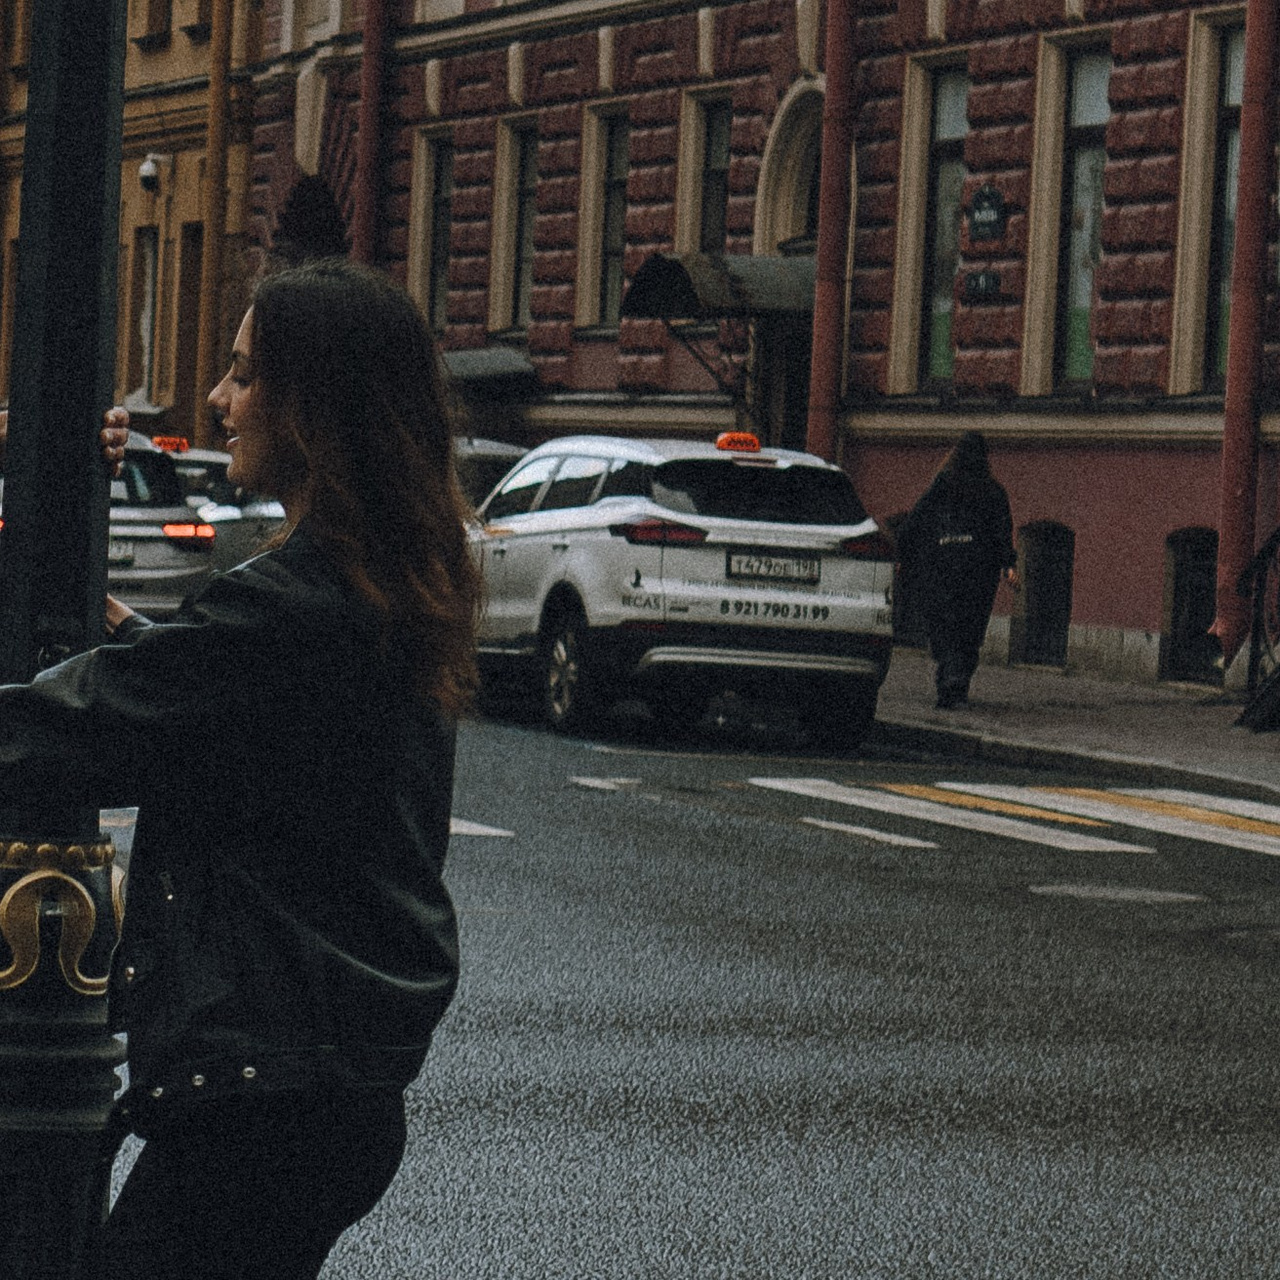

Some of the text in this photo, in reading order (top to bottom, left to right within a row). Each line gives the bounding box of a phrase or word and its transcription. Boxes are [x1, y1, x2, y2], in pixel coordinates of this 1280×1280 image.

[720, 599, 730, 615] 8
[734, 600, 759, 616] 921
[763, 602, 790, 618] 790
[793, 604, 808, 619] 31
[812, 605, 830, 621] 99
